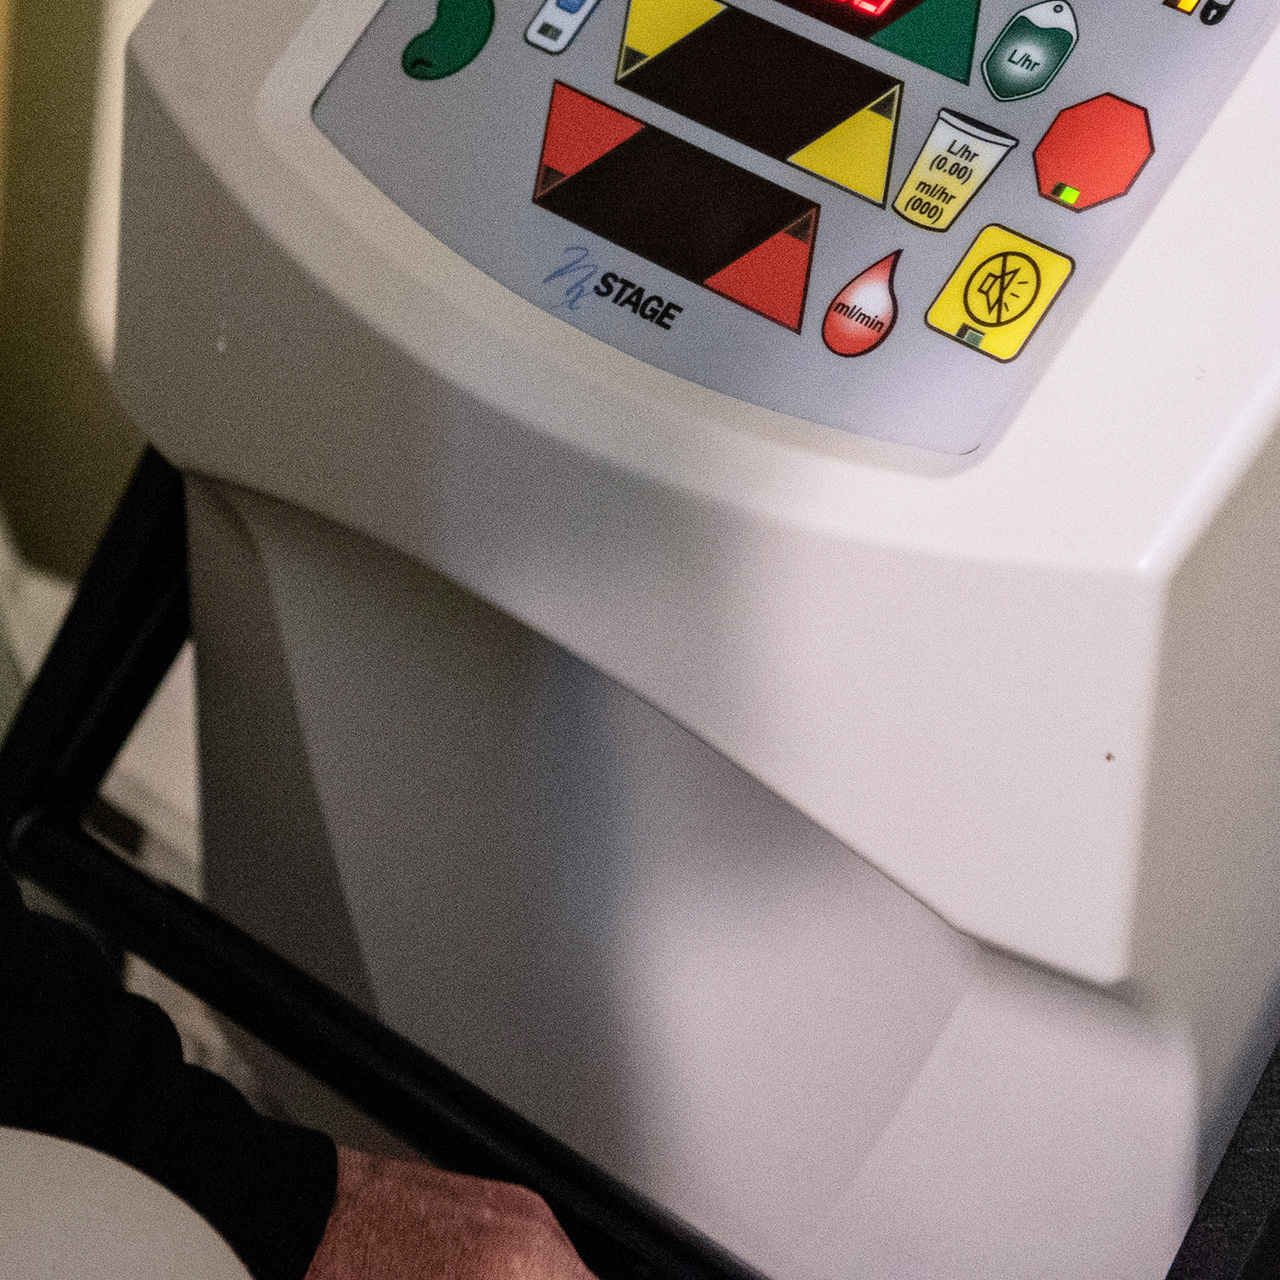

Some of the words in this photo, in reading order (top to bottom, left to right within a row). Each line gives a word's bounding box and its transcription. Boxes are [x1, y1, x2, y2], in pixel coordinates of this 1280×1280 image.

[1006, 48, 1041, 72] L/hr
[946, 139, 980, 163] L/hr
[929, 154, 974, 186] (0.00)
[914, 179, 957, 206] ml/hr
[903, 194, 945, 225] (000)
[593, 271, 684, 331] STAGE
[832, 301, 885, 333] ml/min
